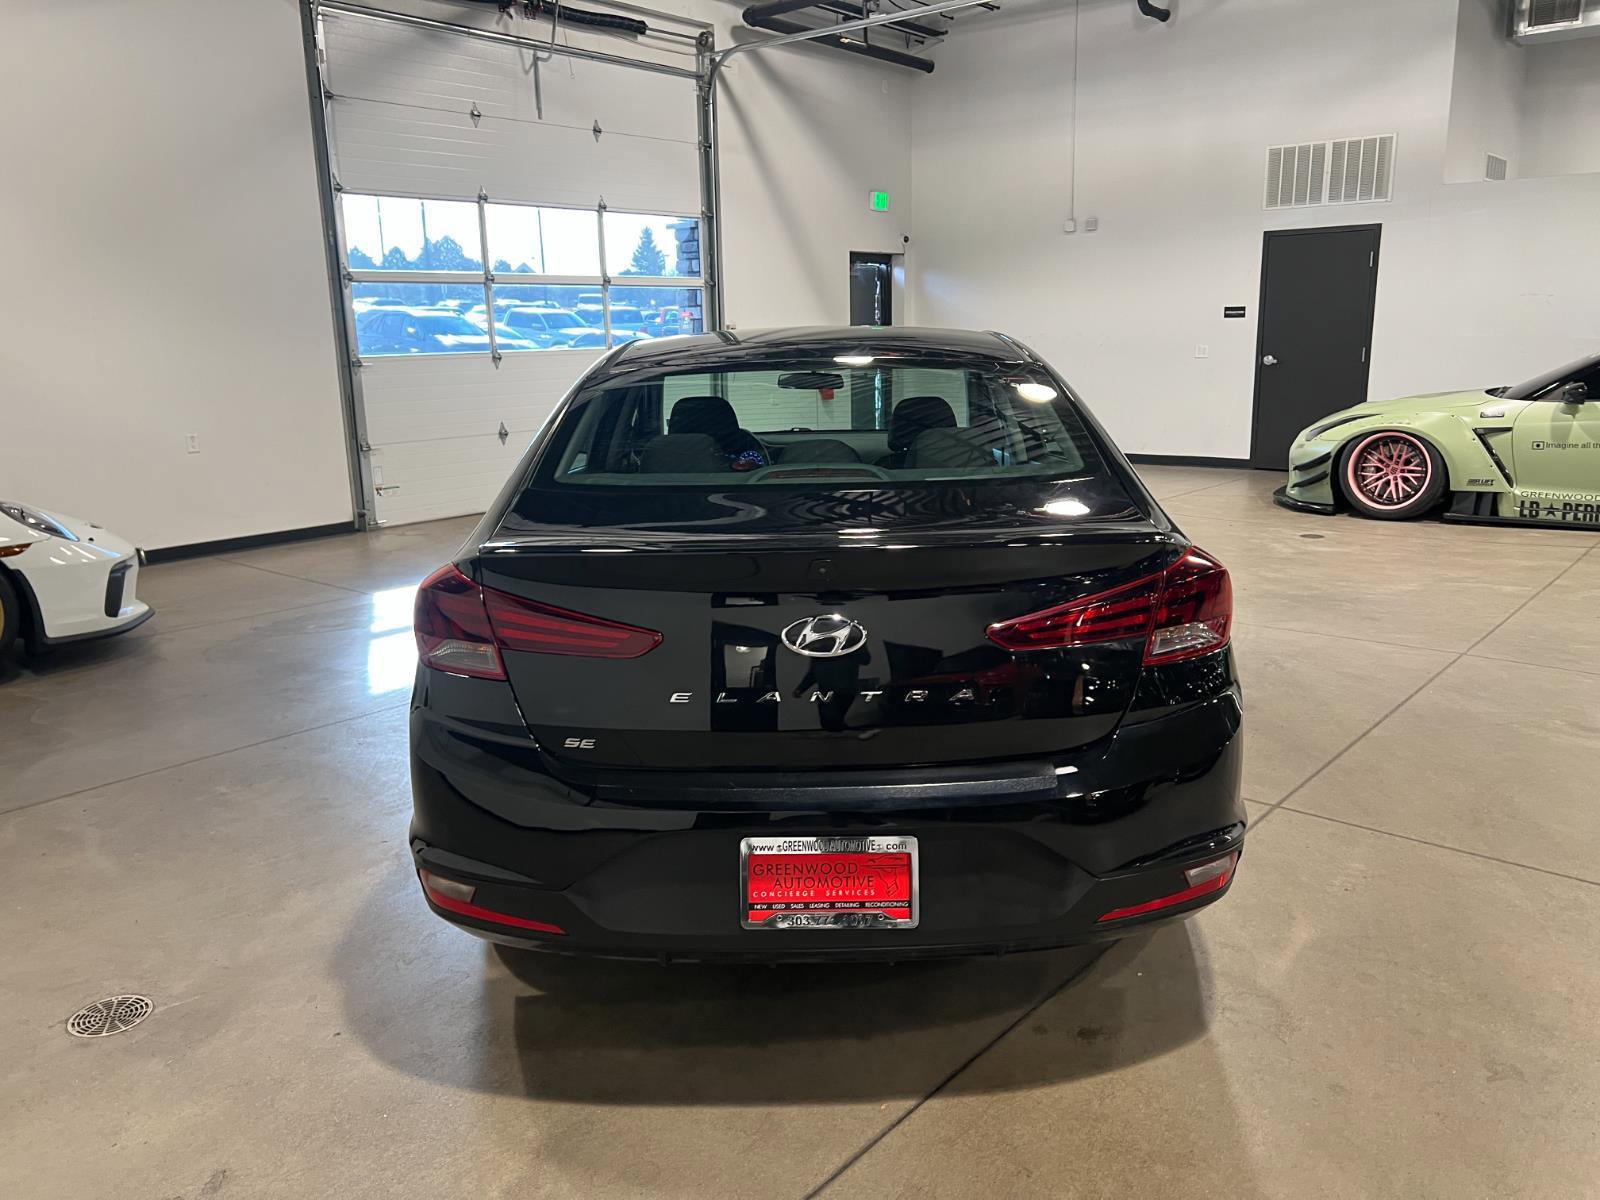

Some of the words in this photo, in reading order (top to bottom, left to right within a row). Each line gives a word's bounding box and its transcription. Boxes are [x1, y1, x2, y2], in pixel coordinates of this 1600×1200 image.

[1546, 441, 1580, 450] Imagine
[1580, 441, 1591, 449] all
[1519, 500, 1540, 518] LB
[669, 689, 975, 703] ELANTRA
[563, 737, 596, 749] SE
[752, 862, 858, 876] GREENWOOD
[773, 875, 874, 889] AUTOMOTIVE
[752, 889, 815, 898] CONCIERGE
[825, 889, 875, 897] SERVICES
